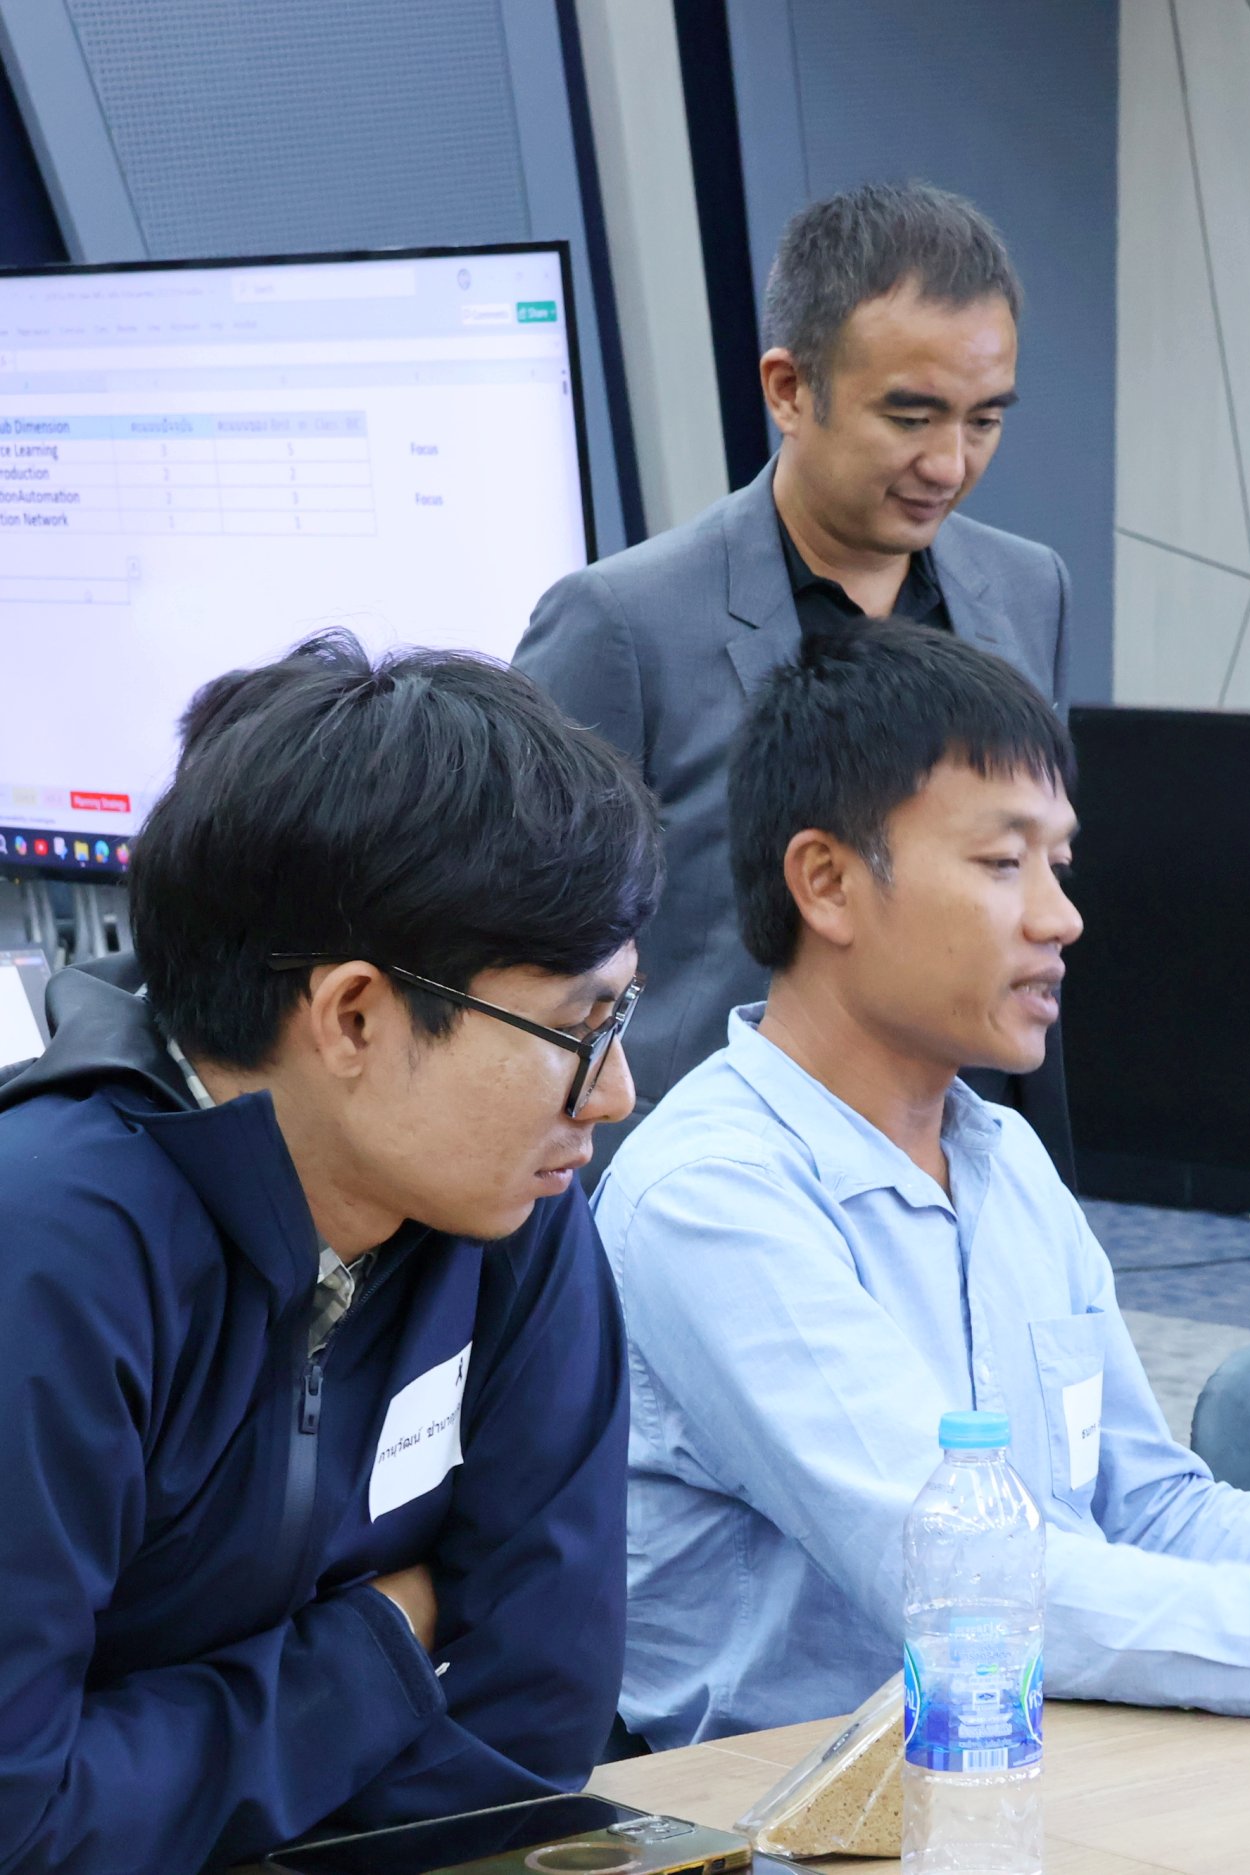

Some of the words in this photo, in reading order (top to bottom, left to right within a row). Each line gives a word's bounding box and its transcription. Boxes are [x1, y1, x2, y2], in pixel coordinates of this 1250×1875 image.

[15, 420, 70, 434] Dimension
[15, 444, 58, 461] Learning
[415, 492, 444, 506] Focus
[24, 512, 68, 526] Network
